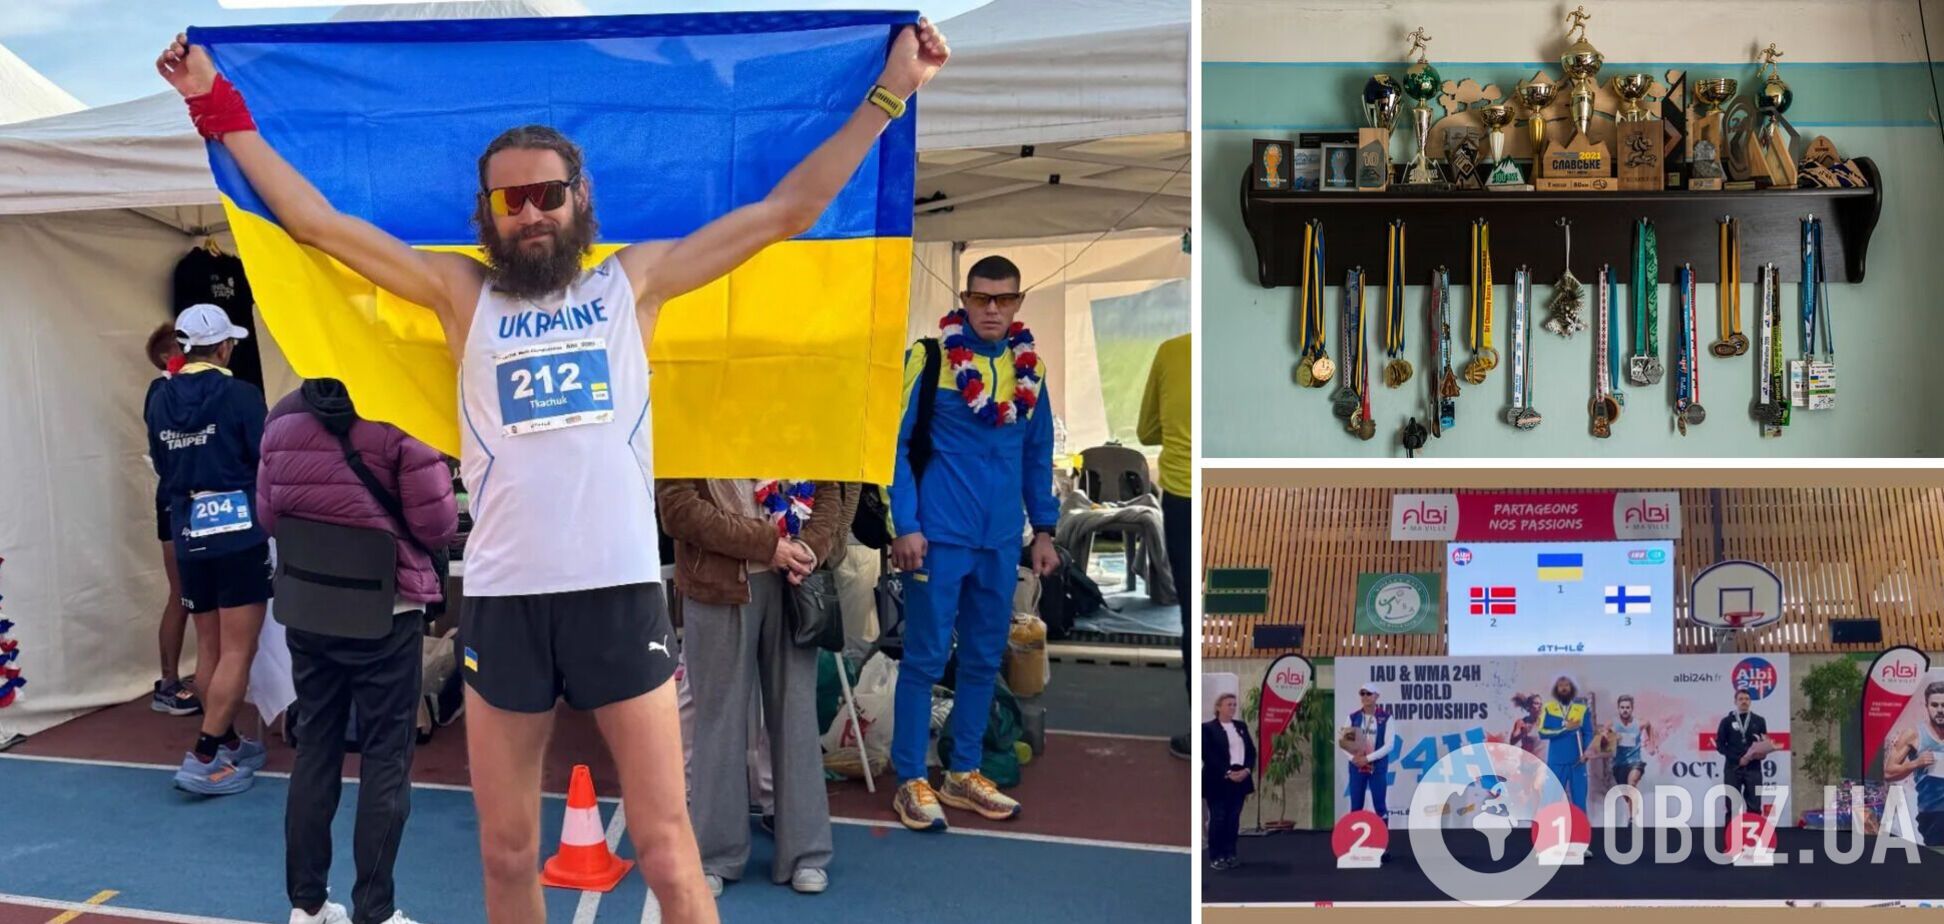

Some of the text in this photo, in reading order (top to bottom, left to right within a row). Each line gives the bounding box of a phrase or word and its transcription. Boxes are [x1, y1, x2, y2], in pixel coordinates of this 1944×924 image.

[1579, 152, 1601, 160] 2021
[1552, 160, 1601, 170] СЛАВСЬКЕ
[499, 297, 608, 338] UKRAINE
[511, 362, 583, 399] 212
[530, 396, 567, 409] Tkachuk
[166, 435, 207, 450] TAIPEI
[196, 498, 234, 518] 204
[1494, 503, 1579, 516] PARTAGEONS
[1489, 519, 1583, 531] NOS PASSIONS
[1558, 585, 1563, 593] 1
[1490, 618, 1497, 627] 2
[1625, 617, 1632, 626] 3
[1370, 665, 1481, 682] IAU & WMA 24H
[1736, 668, 1773, 680] Albi
[1401, 684, 1452, 700] WORLD
[1376, 702, 1489, 720] AMPIONSHIPS
[1672, 761, 1719, 778] OCT.
[1350, 822, 1371, 848] 2
[1552, 816, 1566, 845] 1
[1741, 821, 1760, 849] 3
